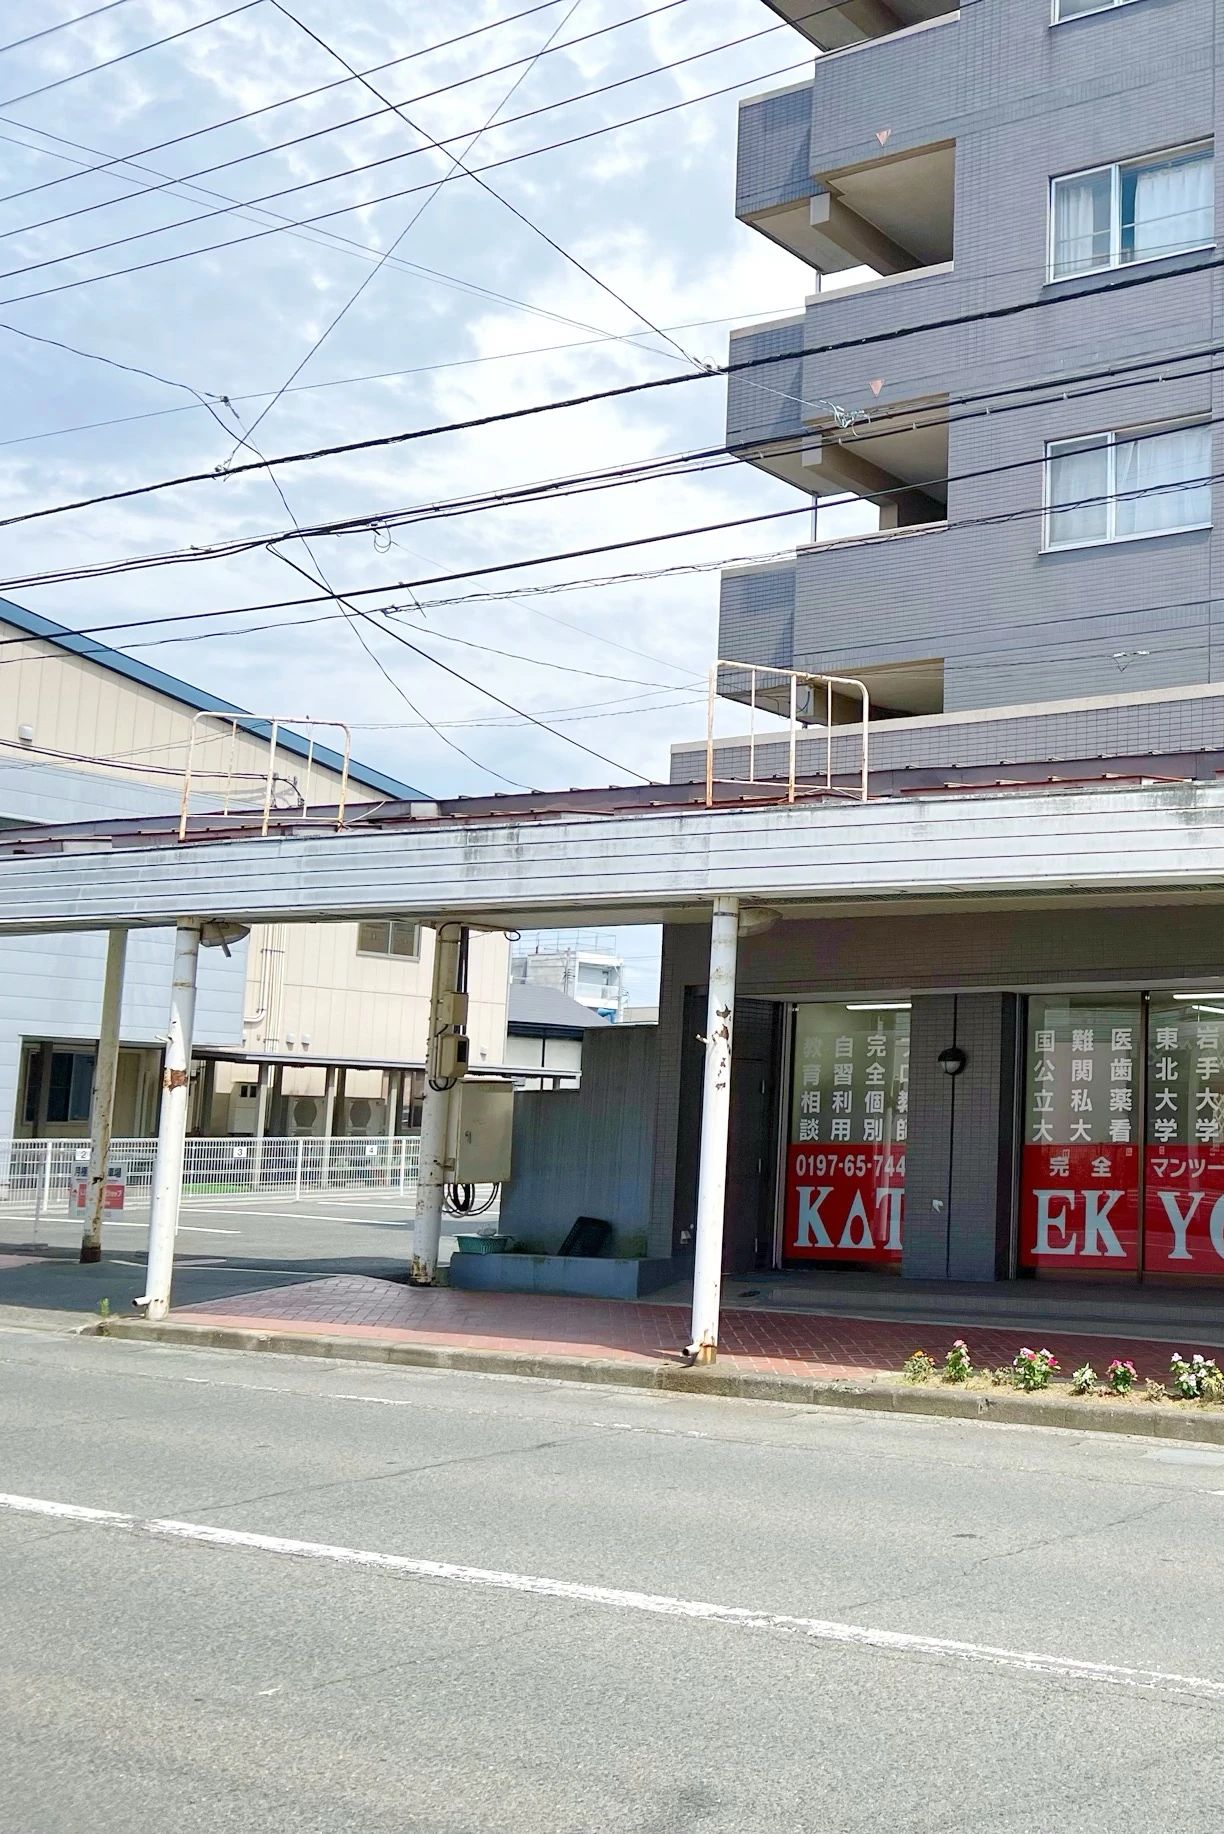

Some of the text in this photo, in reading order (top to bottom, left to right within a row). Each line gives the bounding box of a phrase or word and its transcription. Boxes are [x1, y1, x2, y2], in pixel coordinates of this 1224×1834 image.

[800, 1036, 822, 1141] 教育相談
[831, 1036, 853, 1141] 自習利用
[863, 1035, 886, 1141] 完全個別
[1033, 1030, 1056, 1142] 国公立大
[1070, 1029, 1094, 1142] 難関私大
[1109, 1028, 1133, 1143] 医歯薬看
[1154, 1027, 1178, 1143] 東北大学
[1195, 1026, 1219, 1143] 岩手大学
